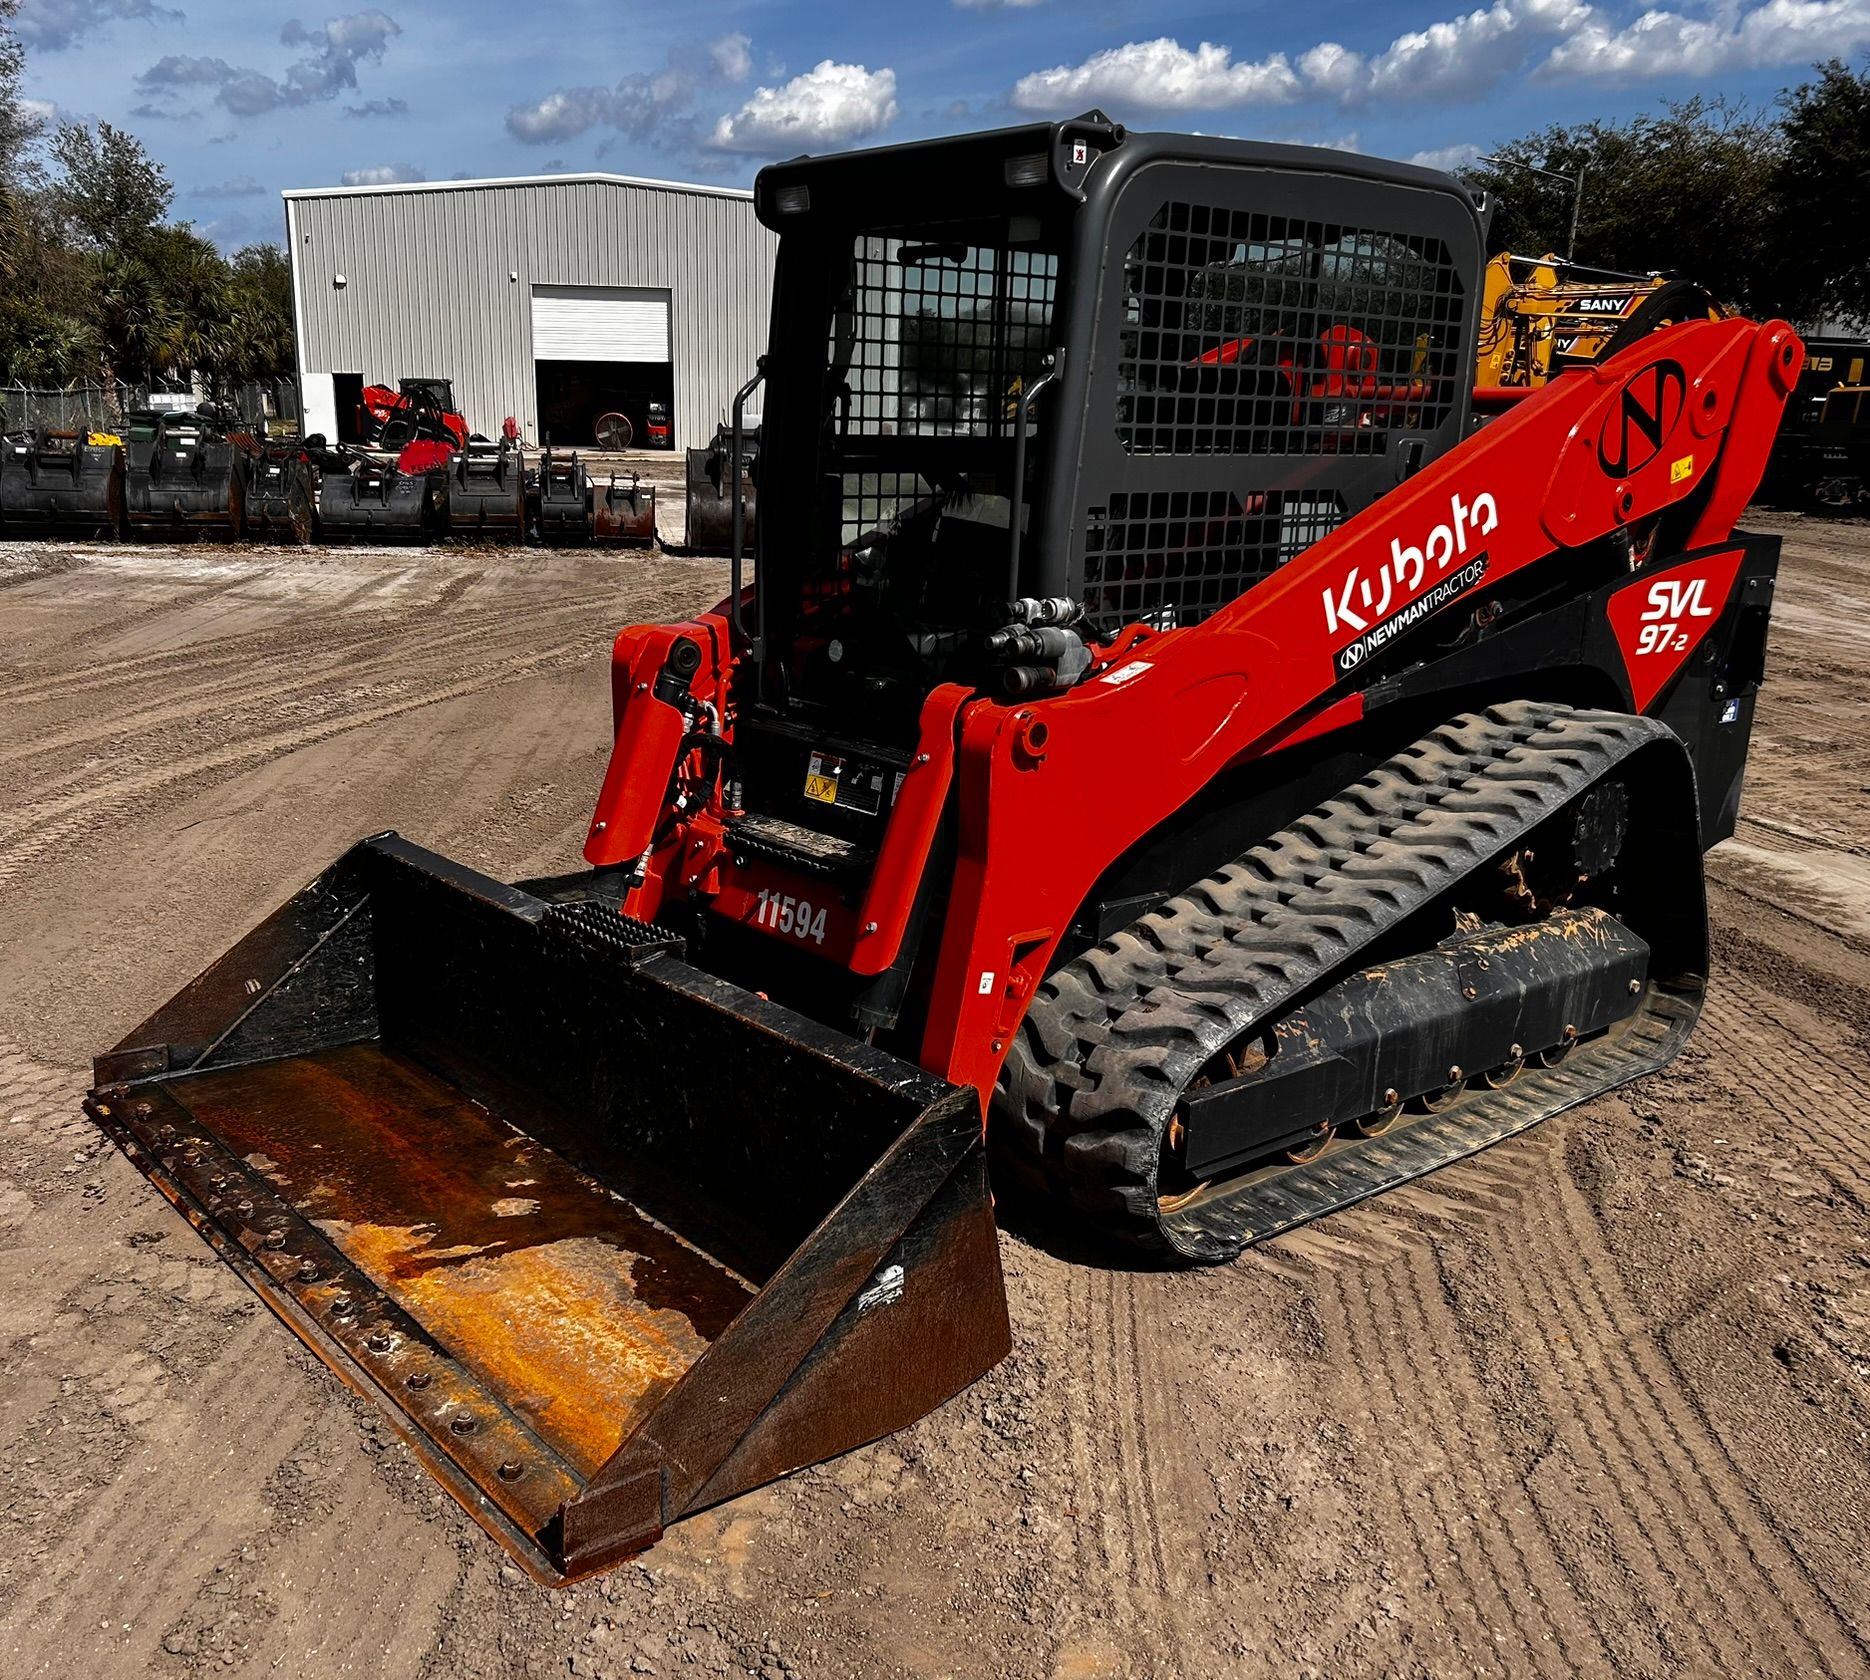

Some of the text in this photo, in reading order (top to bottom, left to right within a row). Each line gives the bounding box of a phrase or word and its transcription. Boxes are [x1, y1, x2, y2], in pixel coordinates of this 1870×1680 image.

[1580, 299, 1625, 311] SANY
[1322, 491, 1499, 634] Kubota
[1367, 559, 1485, 652] NEWMANTRACTOR
[1640, 579, 1712, 621] SVL
[1635, 623, 1688, 655] 97-2
[757, 888, 827, 944] 11594
